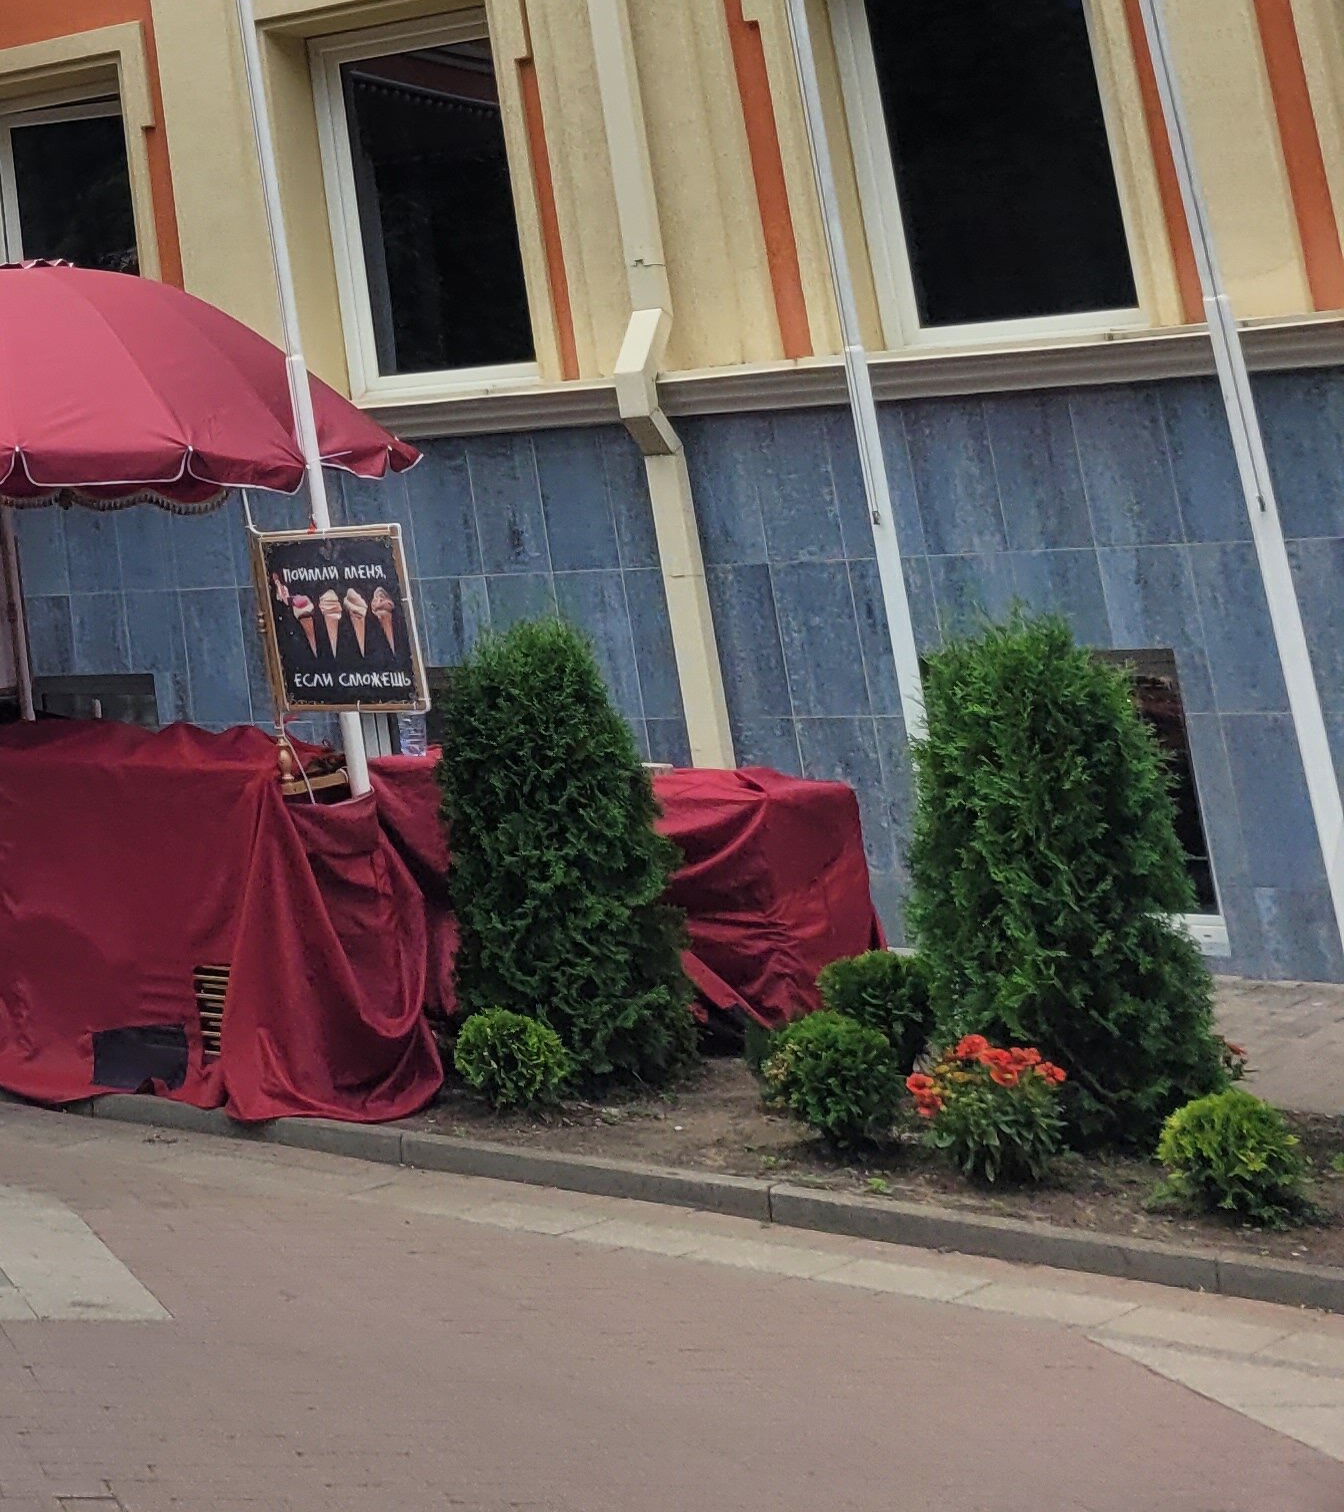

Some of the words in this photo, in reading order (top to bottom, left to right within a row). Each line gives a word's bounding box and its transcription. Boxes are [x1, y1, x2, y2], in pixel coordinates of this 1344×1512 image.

[282, 565, 339, 583] ПОЙМАЙ
[294, 672, 334, 688] ЕСЛИ
[338, 671, 412, 688] СМОЖЕШЬ
